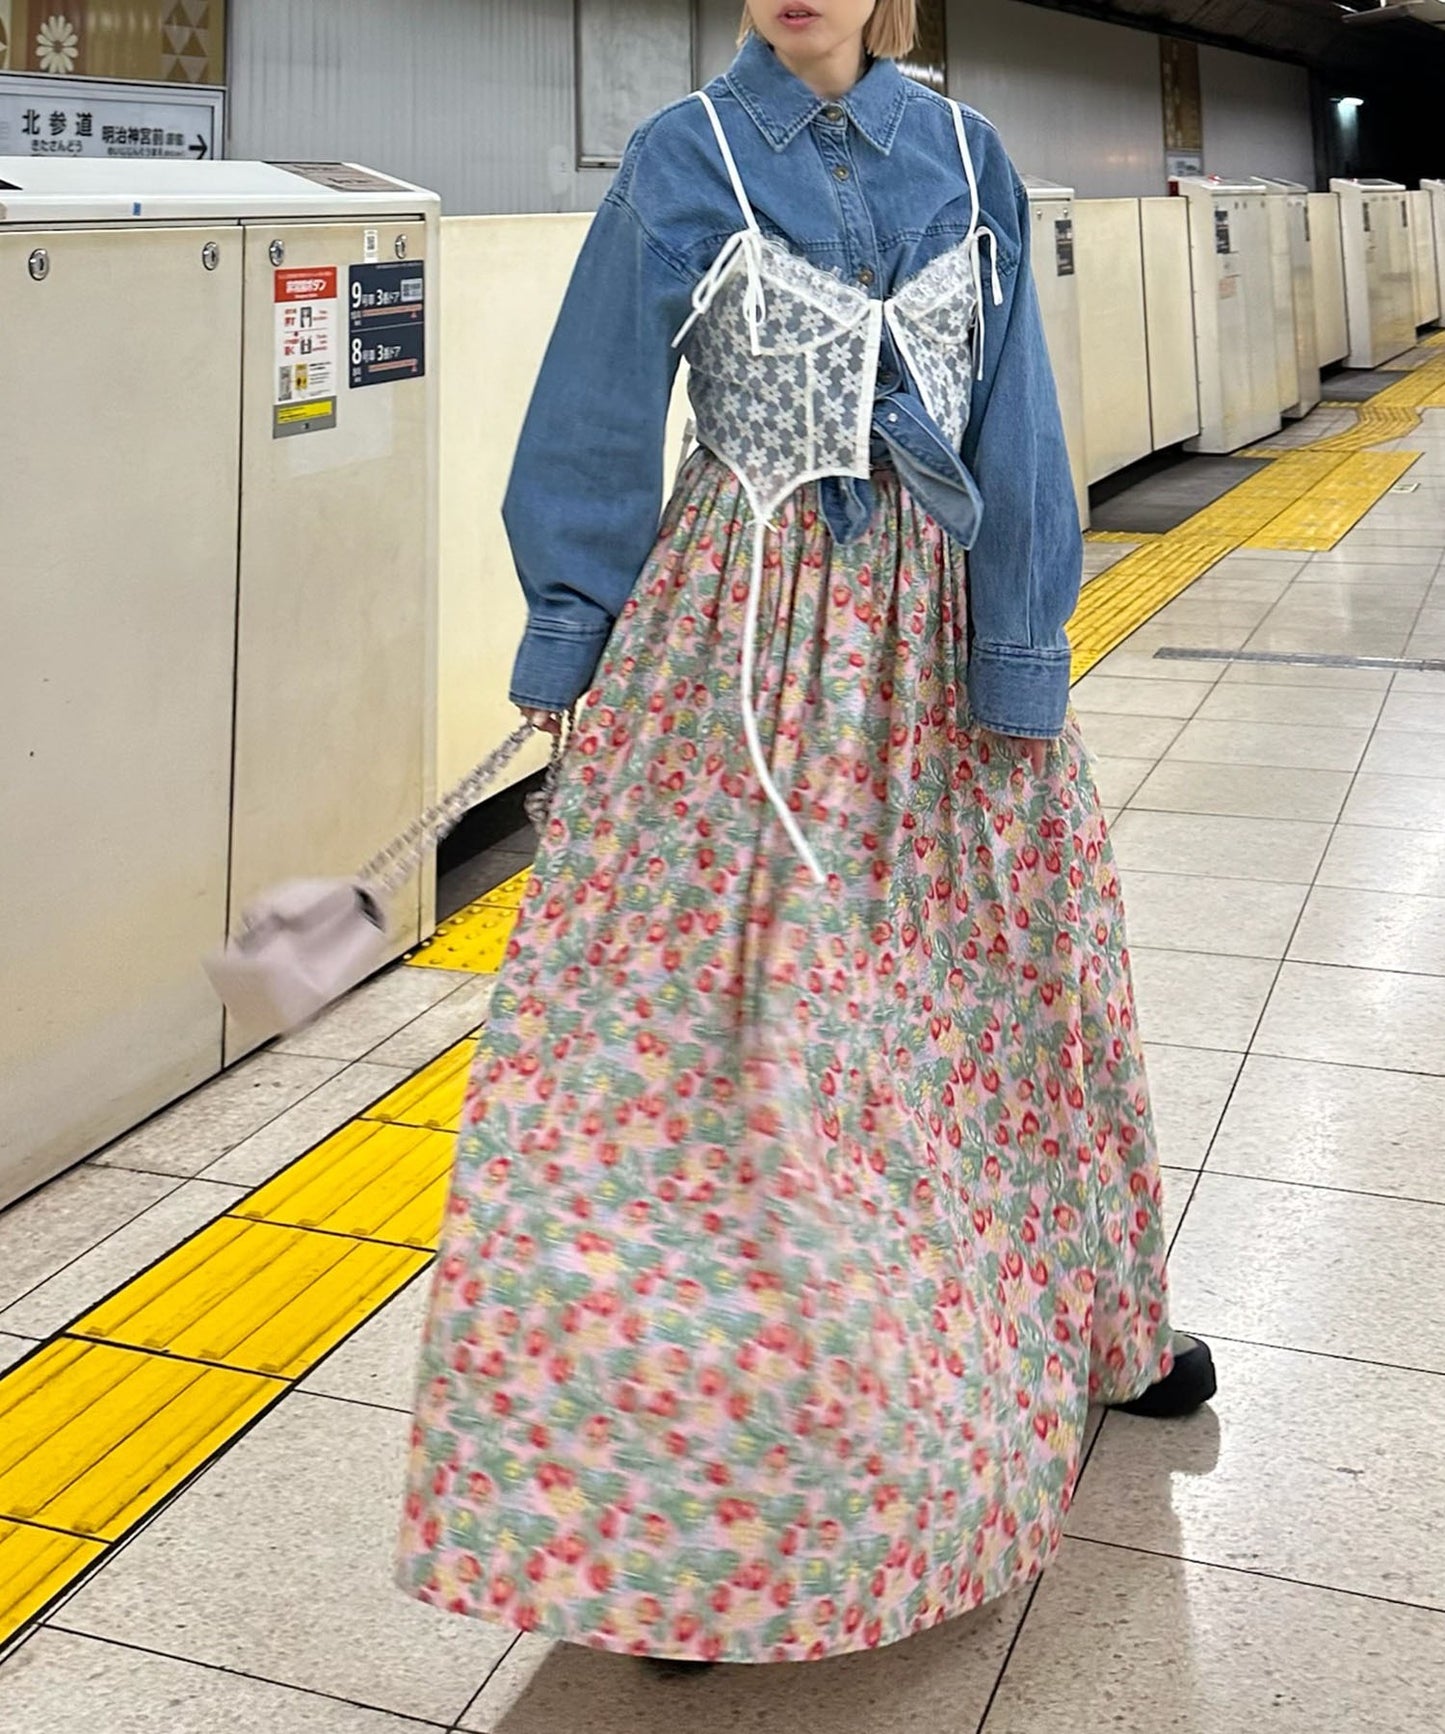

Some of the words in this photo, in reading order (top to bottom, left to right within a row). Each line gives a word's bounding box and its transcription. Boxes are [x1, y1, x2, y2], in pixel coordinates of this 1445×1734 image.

[22, 109, 93, 137] 北参道
[31, 139, 83, 152] きたさんどう
